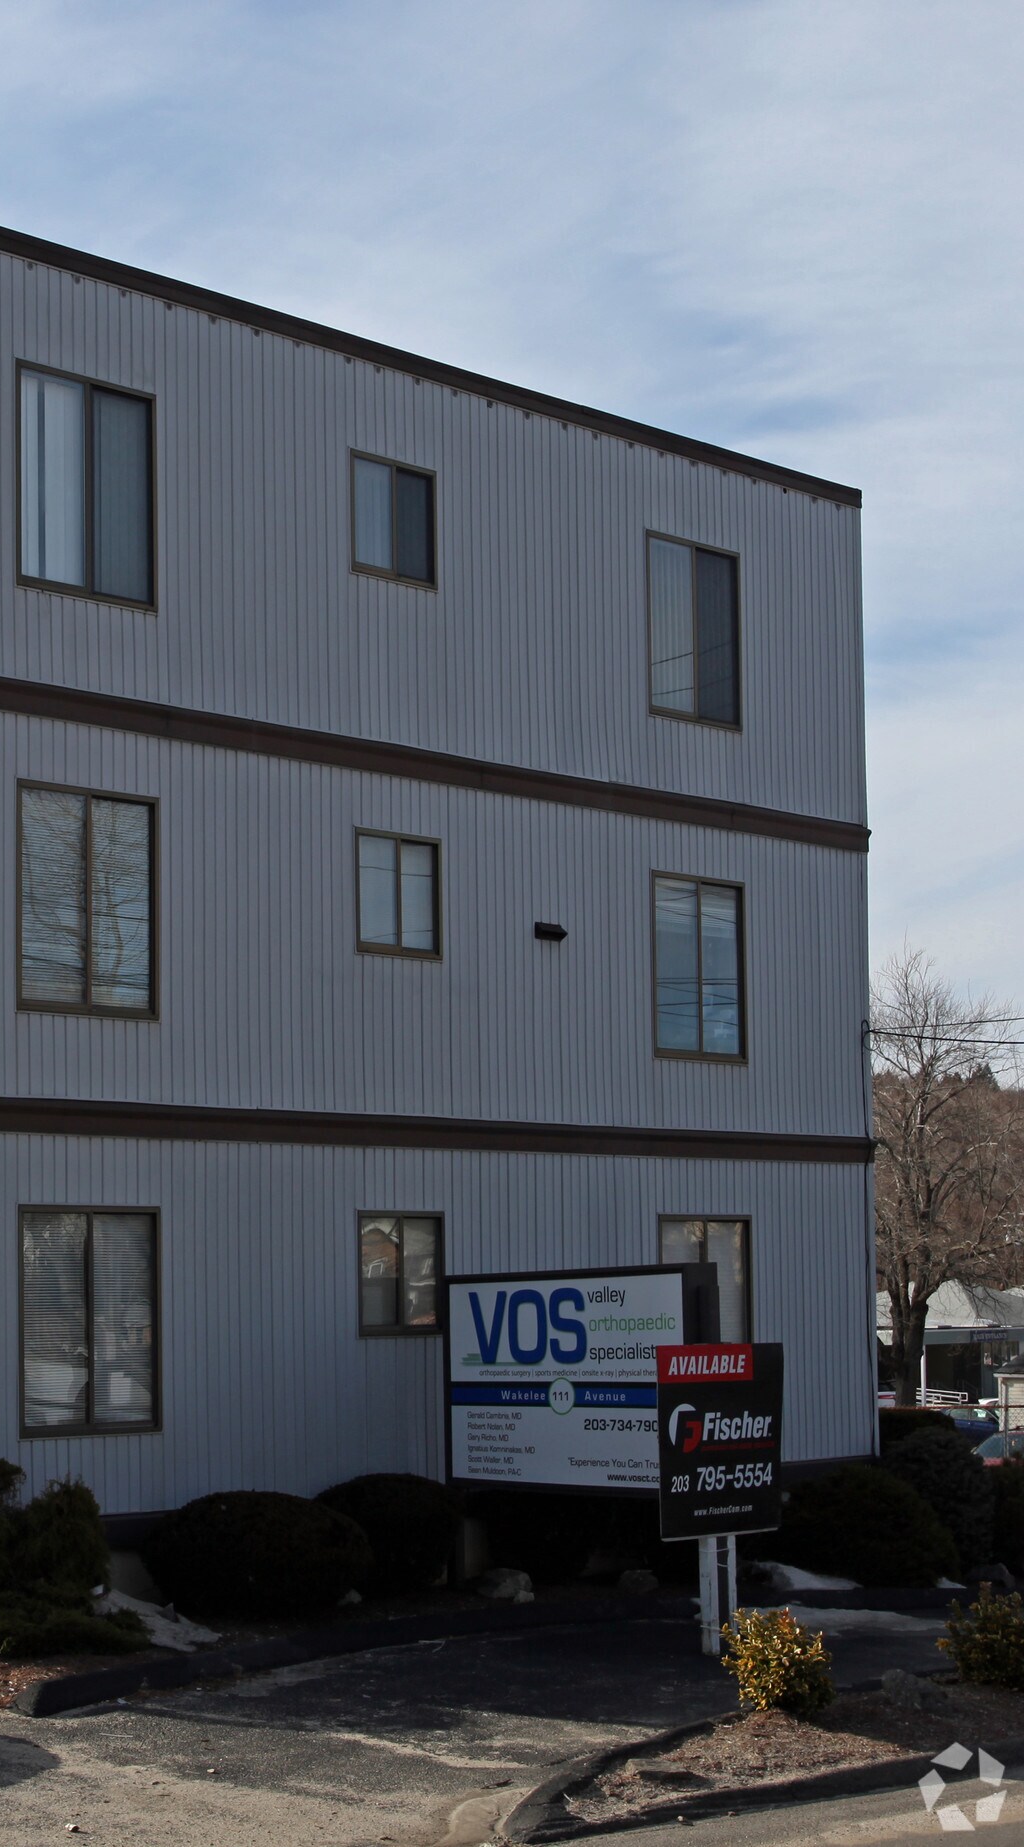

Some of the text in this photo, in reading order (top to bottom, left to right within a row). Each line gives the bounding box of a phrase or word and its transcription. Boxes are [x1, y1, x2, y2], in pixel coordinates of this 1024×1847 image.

[587, 1286, 626, 1307] valley
[468, 1287, 588, 1365] VOS
[588, 1313, 676, 1335] orthopaedic
[668, 1354, 746, 1376] AVAILABLE
[479, 1368, 510, 1377] orthopaedic
[534, 1369, 551, 1377] sports
[552, 1368, 578, 1377] medicine
[581, 1369, 599, 1377] onsite
[618, 1368, 642, 1378] physical
[501, 1390, 626, 1402] Wakelee 111 Avenue
[511, 1412, 522, 1420] MD
[505, 1423, 516, 1431] MD
[702, 1410, 772, 1441] Fischer
[524, 1446, 536, 1454] MD
[503, 1456, 514, 1465] MD
[611, 1459, 627, 1468] You
[627, 1459, 643, 1468] Can
[671, 1462, 773, 1493] 203 795-5554
